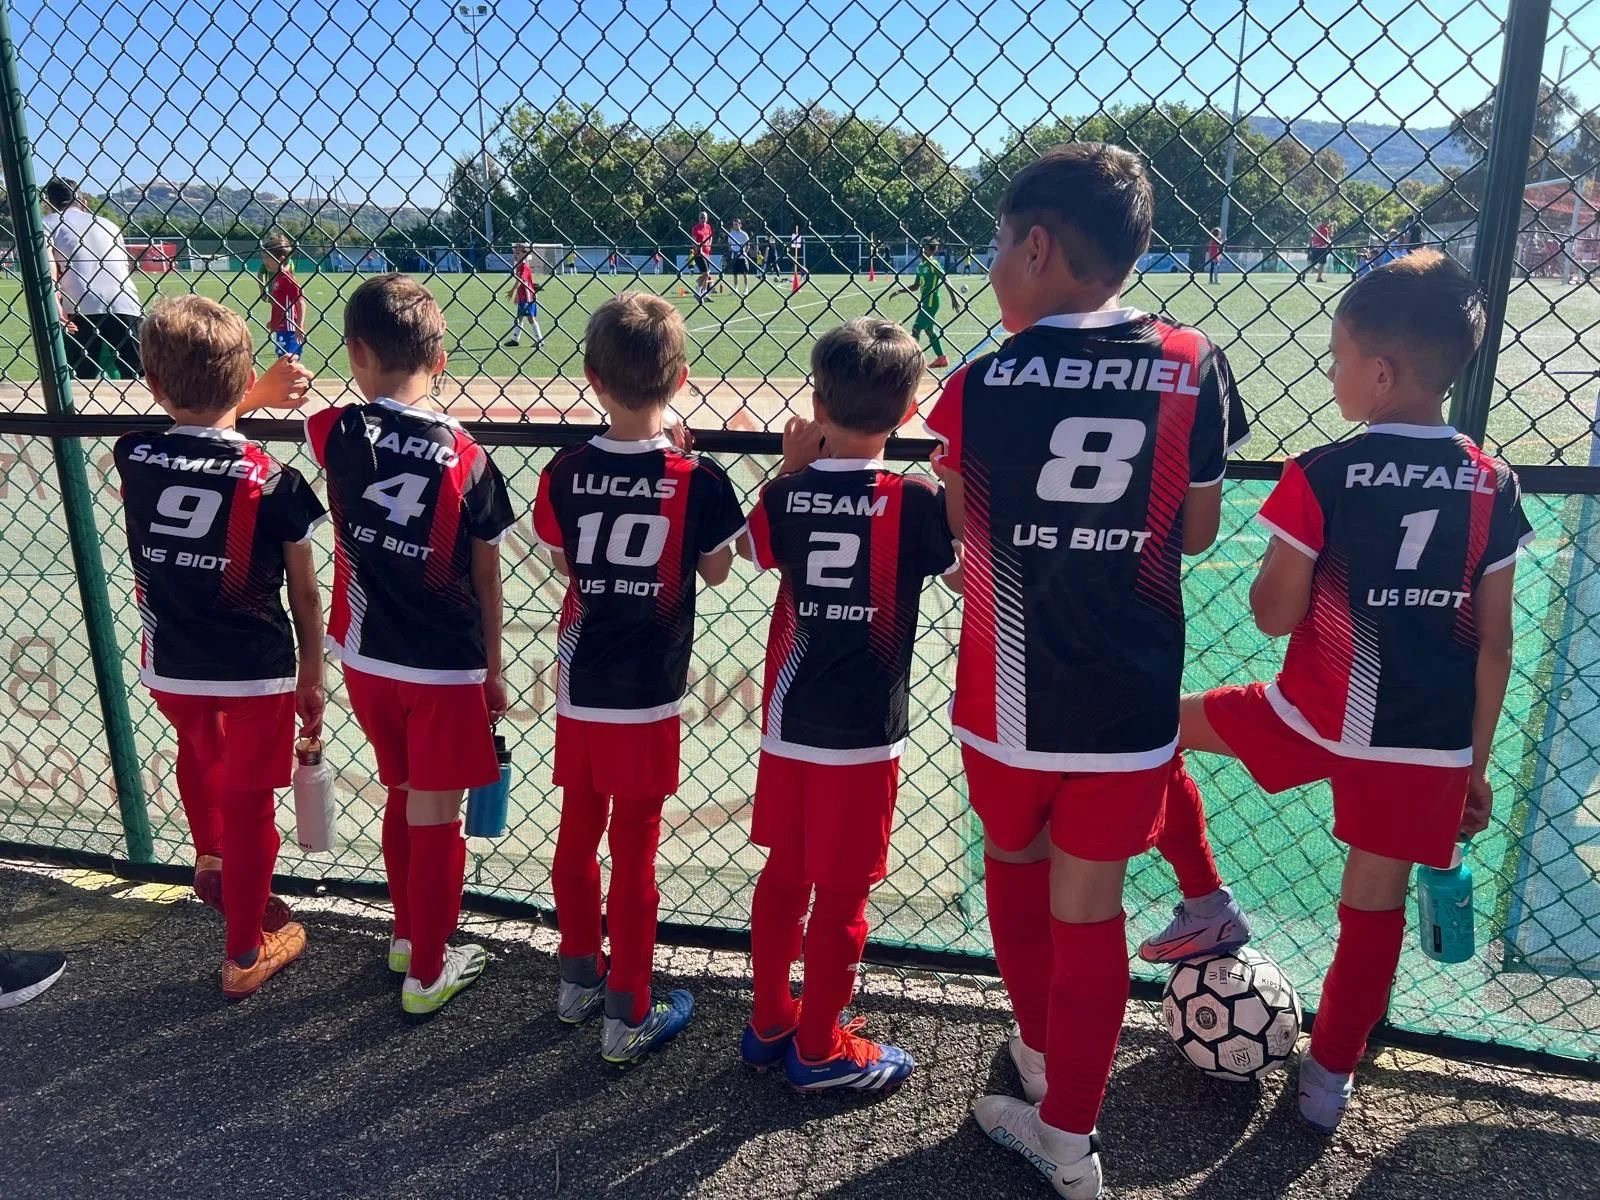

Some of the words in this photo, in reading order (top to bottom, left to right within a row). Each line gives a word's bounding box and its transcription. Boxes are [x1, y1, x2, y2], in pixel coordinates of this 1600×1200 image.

[984, 358, 1200, 396] GABRIEL
[128, 444, 266, 484] SAMUEL
[364, 423, 459, 468] DARIO
[1036, 416, 1147, 503] 8
[572, 473, 678, 499] LUCAS
[1345, 459, 1495, 495] RAFAËL
[149, 485, 223, 539] 9
[361, 472, 430, 527] 4
[786, 490, 888, 517] ISSAM
[382, 535, 434, 561] BIOT
[576, 511, 671, 567] 10
[1013, 524, 1057, 550] US
[1070, 526, 1152, 553] BIOT
[1394, 509, 1439, 570] 1
[142, 545, 168, 563] US
[175, 551, 231, 571] BIOT
[806, 531, 860, 589] 2
[580, 579, 606, 594] US
[614, 579, 664, 597] BIOT
[1367, 588, 1399, 607] US
[1405, 588, 1470, 609] BIOT
[826, 604, 878, 622] BIOT
